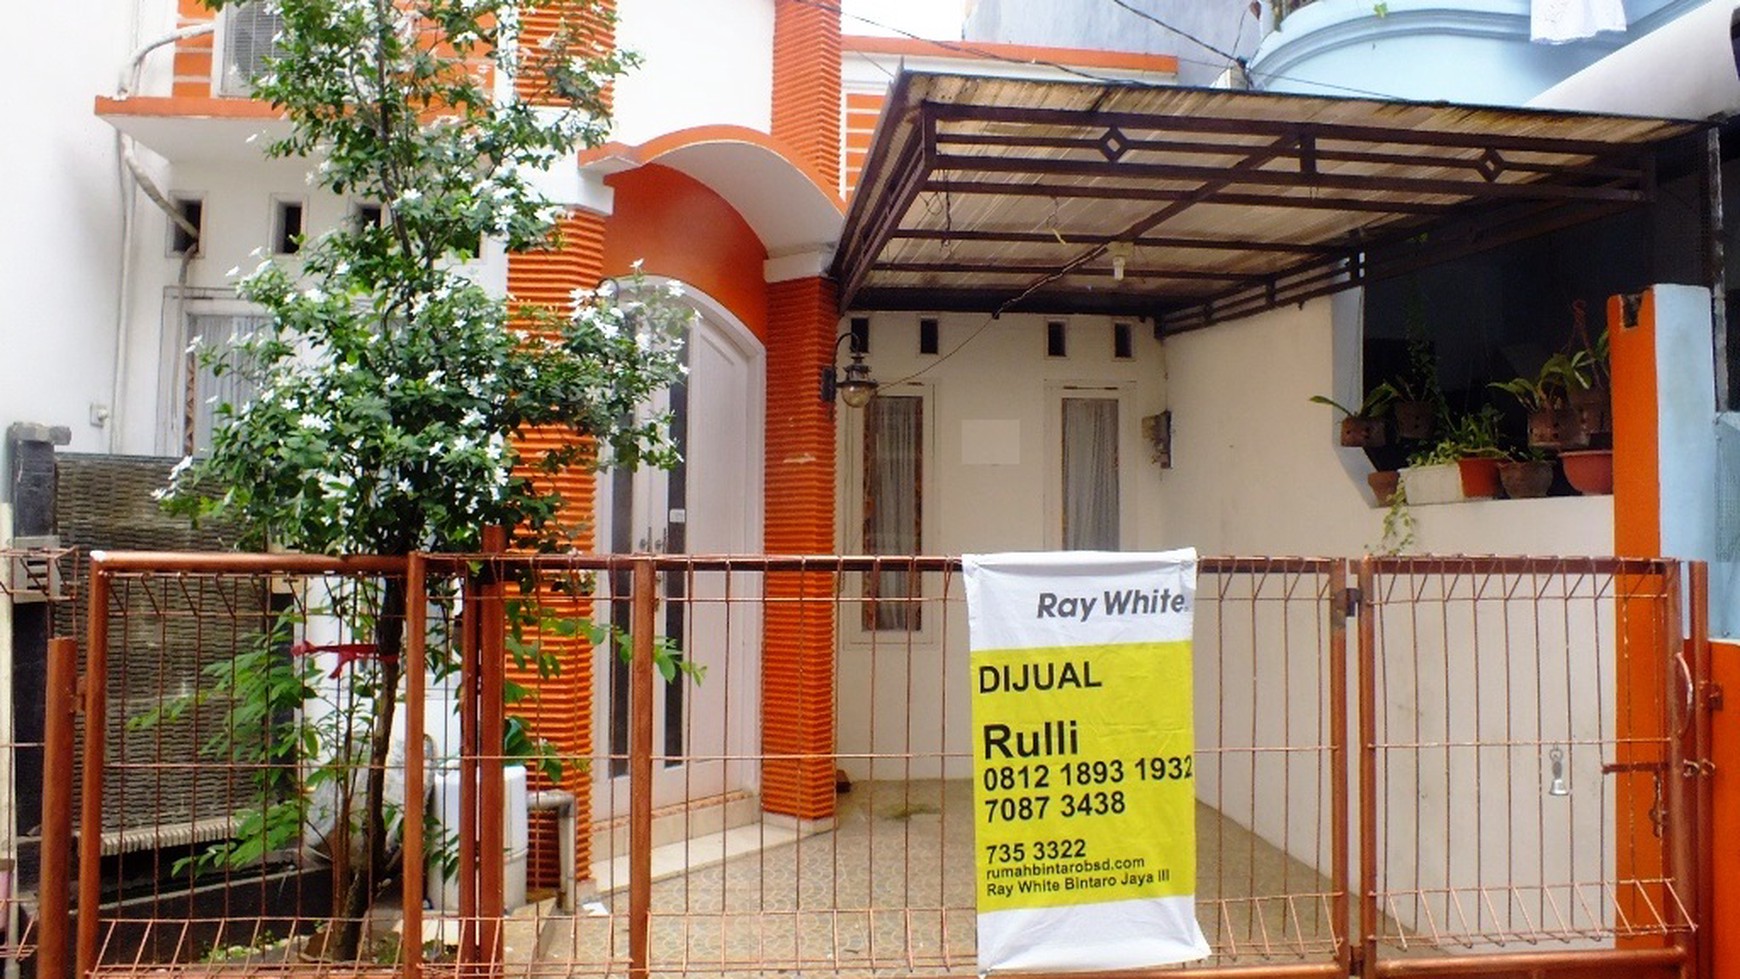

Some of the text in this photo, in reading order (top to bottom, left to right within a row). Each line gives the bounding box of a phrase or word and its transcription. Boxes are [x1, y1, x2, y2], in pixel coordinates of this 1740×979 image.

[1036, 589, 1185, 622] Ray White
[979, 661, 1102, 694] DIJUAL
[983, 721, 1079, 760] Rulli
[984, 756, 1192, 791] 0812 1893 1932
[985, 791, 1125, 822] 7087 3438
[986, 839, 1086, 863] 735 3322
[987, 857, 1145, 879] rumahbintarobsd.com
[987, 882, 1013, 898] Ray
[1016, 878, 1060, 894] White
[1065, 874, 1116, 890] Bintaro
[1121, 871, 1154, 889] Jaya
